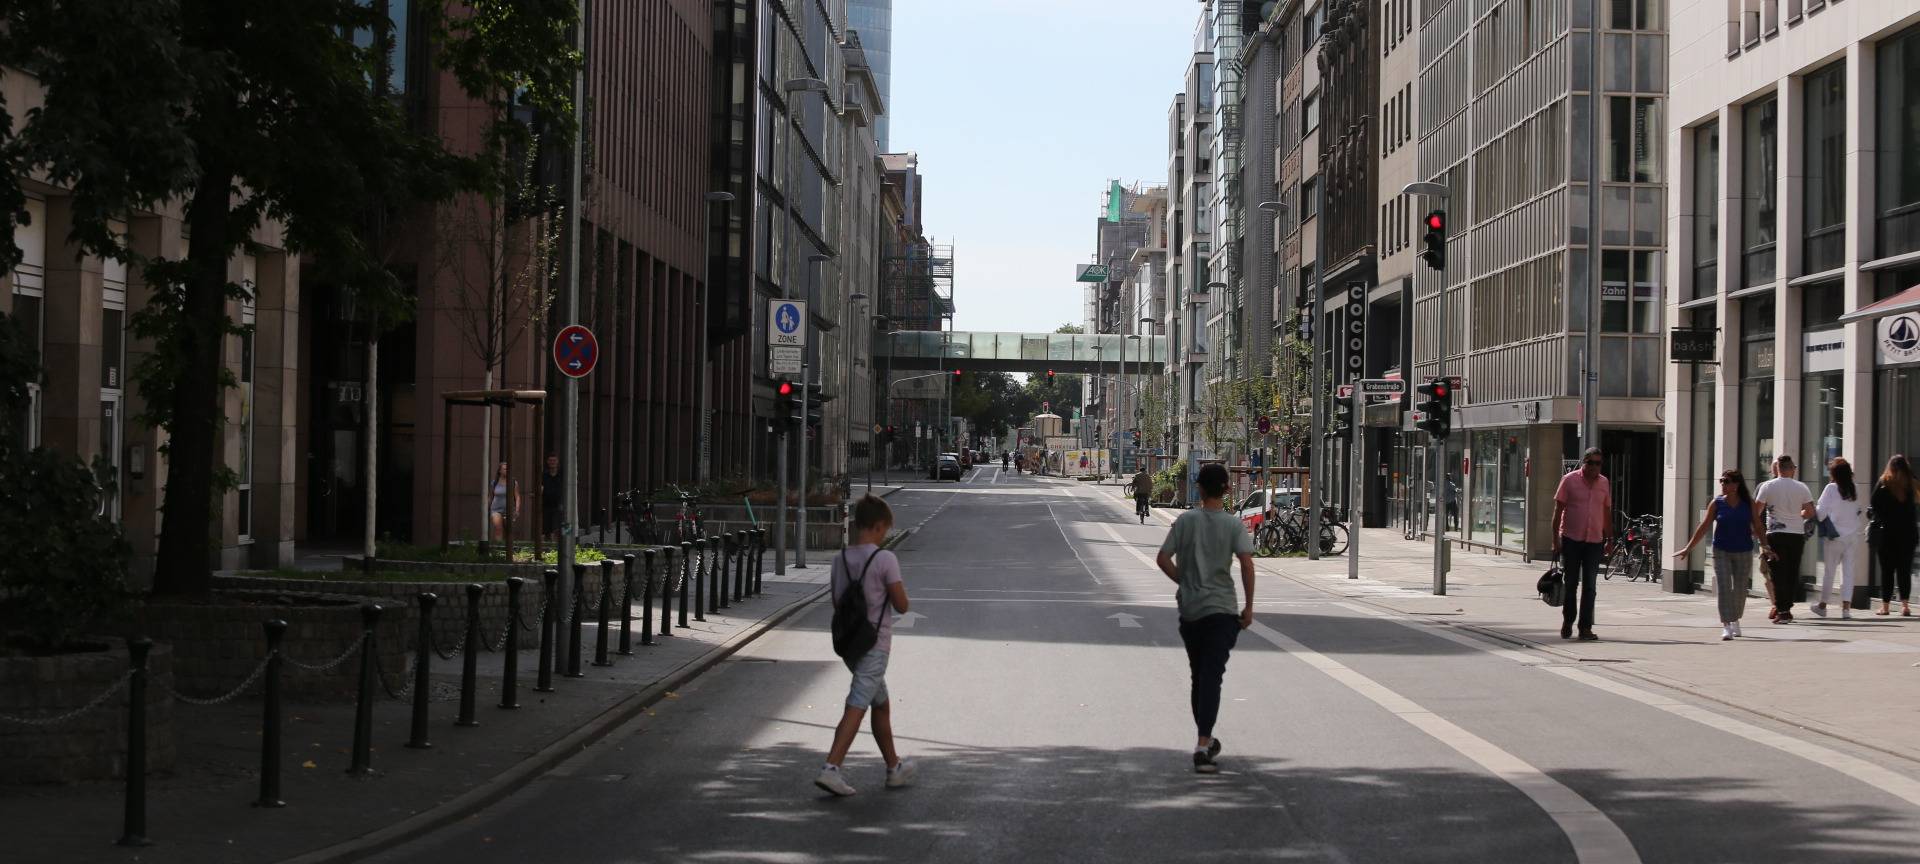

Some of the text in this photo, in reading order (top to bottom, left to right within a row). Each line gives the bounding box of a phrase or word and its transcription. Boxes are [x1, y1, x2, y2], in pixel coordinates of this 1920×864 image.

[1086, 265, 1107, 275] AOK
[1602, 286, 1626, 295] Zahn
[777, 335, 797, 343] ZONE
[1883, 339, 1901, 356] PETIT
[1366, 382, 1400, 391] Grabenstraße
